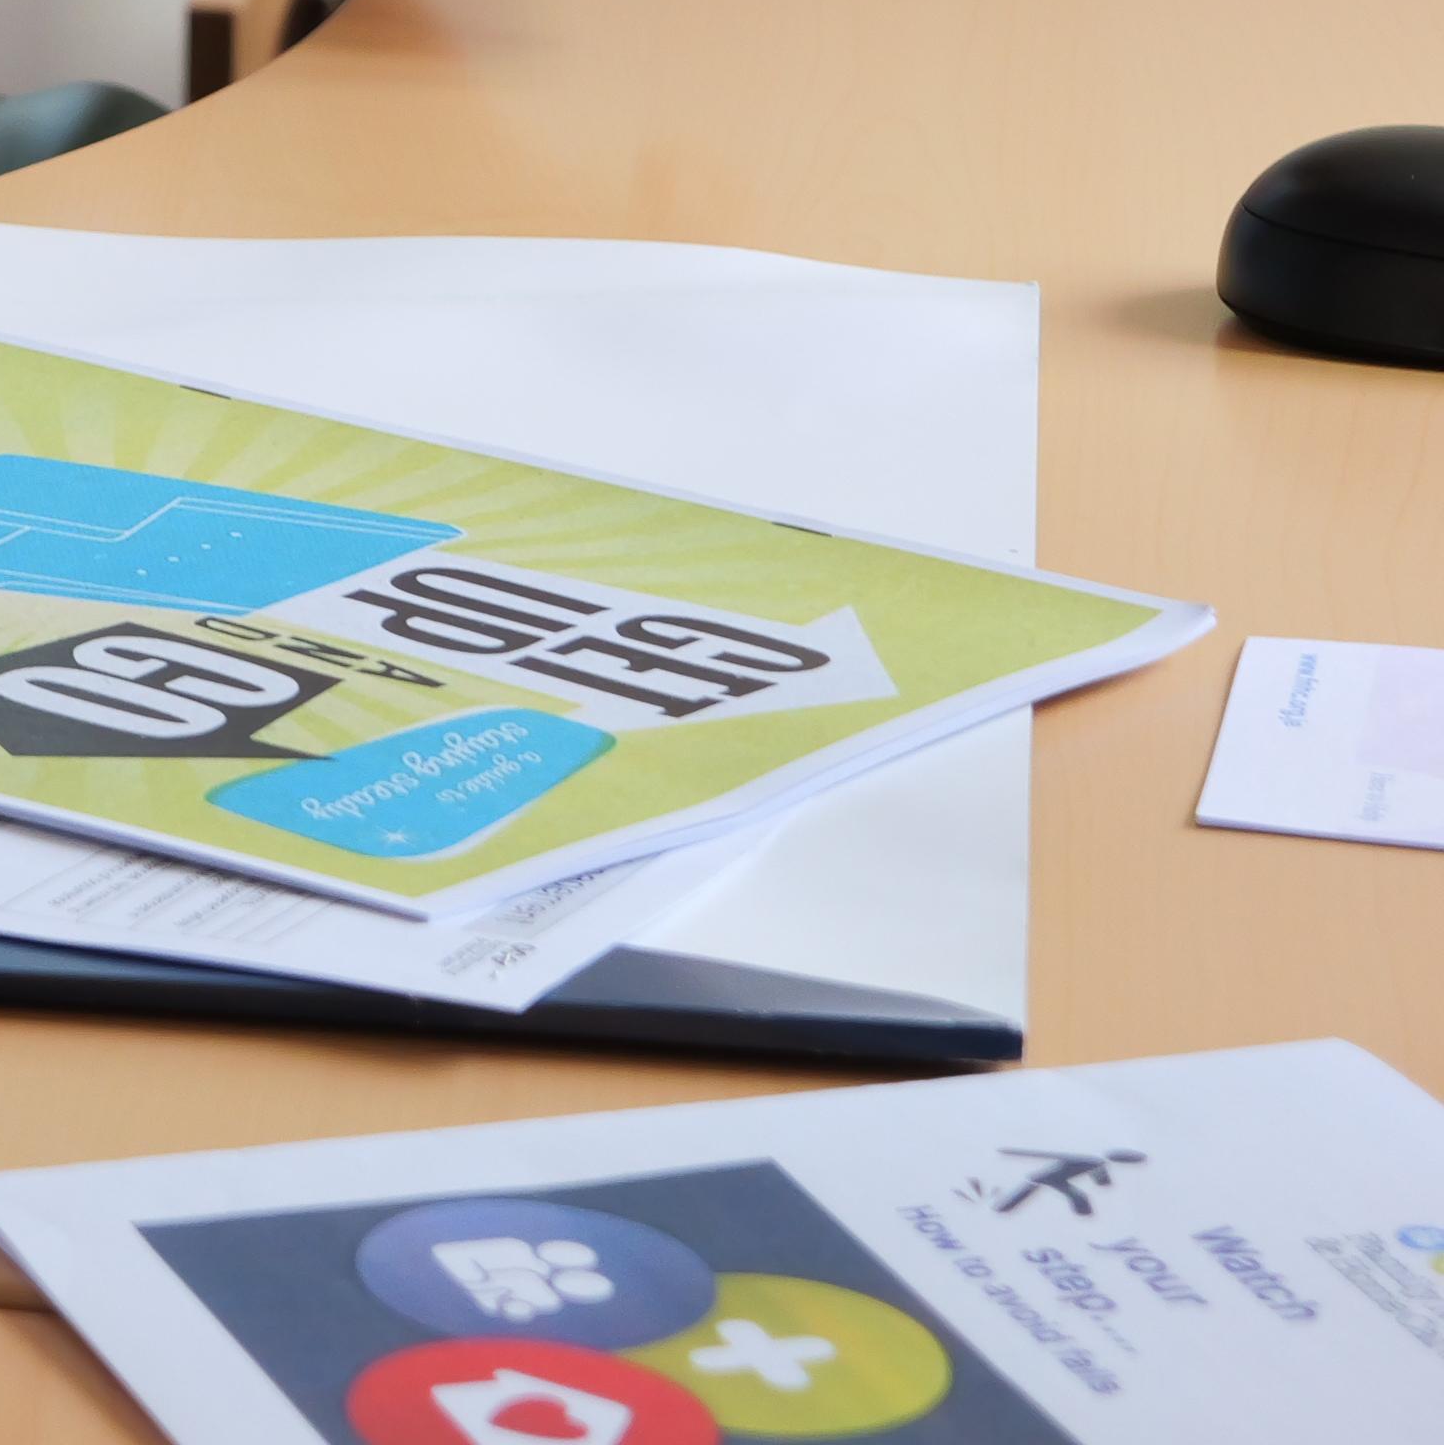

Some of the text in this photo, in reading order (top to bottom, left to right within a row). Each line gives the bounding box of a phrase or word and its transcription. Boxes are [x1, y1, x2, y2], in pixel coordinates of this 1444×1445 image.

[343, 567, 612, 655] UP
[509, 614, 831, 719] GET
[300, 721, 530, 819] staying steady
[897, 1203, 967, 1252] How
[1088, 1236, 1209, 1308] your
[1192, 1224, 1321, 1323] Watch
